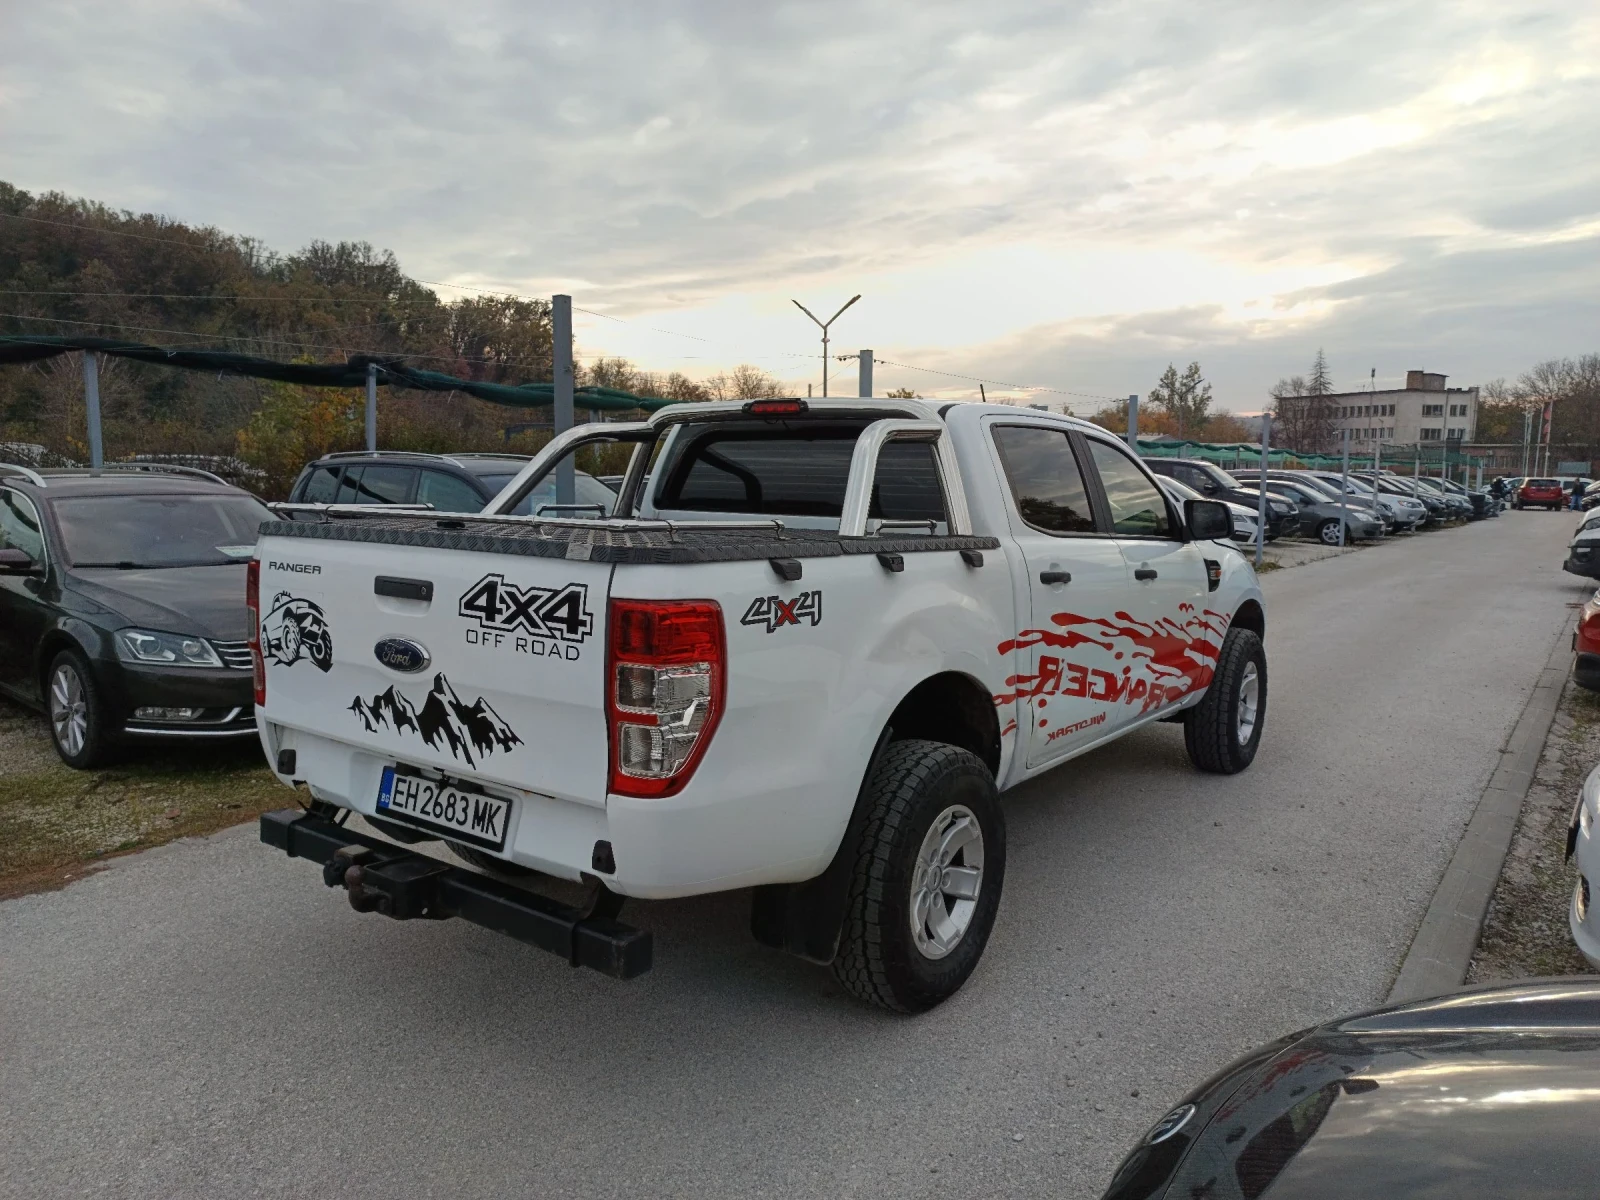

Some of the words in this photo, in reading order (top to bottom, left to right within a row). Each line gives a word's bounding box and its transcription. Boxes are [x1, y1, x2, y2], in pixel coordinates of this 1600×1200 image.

[269, 561, 321, 574] RANGER
[466, 629, 505, 647] OFF
[516, 637, 580, 661] ROAD
